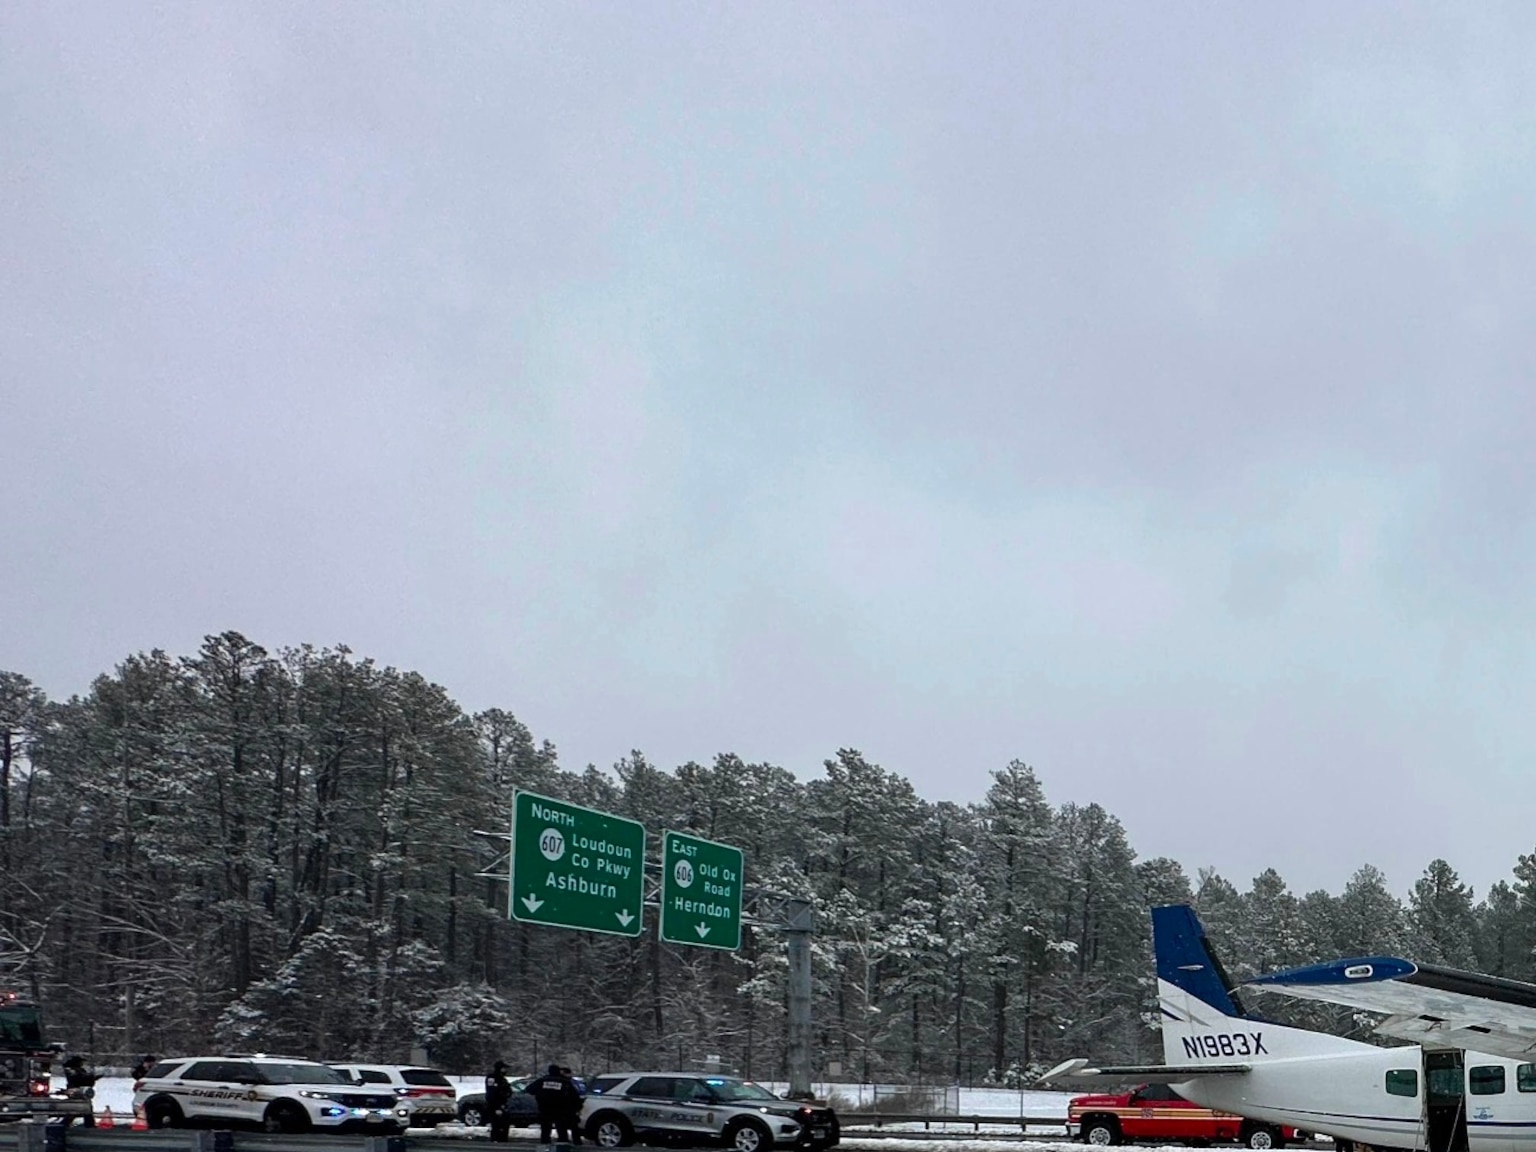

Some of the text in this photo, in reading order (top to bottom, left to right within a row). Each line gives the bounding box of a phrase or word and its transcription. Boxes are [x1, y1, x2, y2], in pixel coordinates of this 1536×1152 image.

[531, 802, 575, 827] NORTH
[541, 833, 563, 855] 607
[572, 833, 632, 859] Loudoun
[672, 839, 698, 857] EAST
[571, 853, 631, 880] Co Pkwy
[676, 862, 693, 882] 606
[699, 863, 736, 882] Old Ox
[545, 871, 617, 899] Ashburn
[704, 881, 731, 897] Road
[675, 897, 731, 919] Herndon
[1181, 1032, 1269, 1059] N1983X
[191, 1089, 244, 1099] SHERIFF
